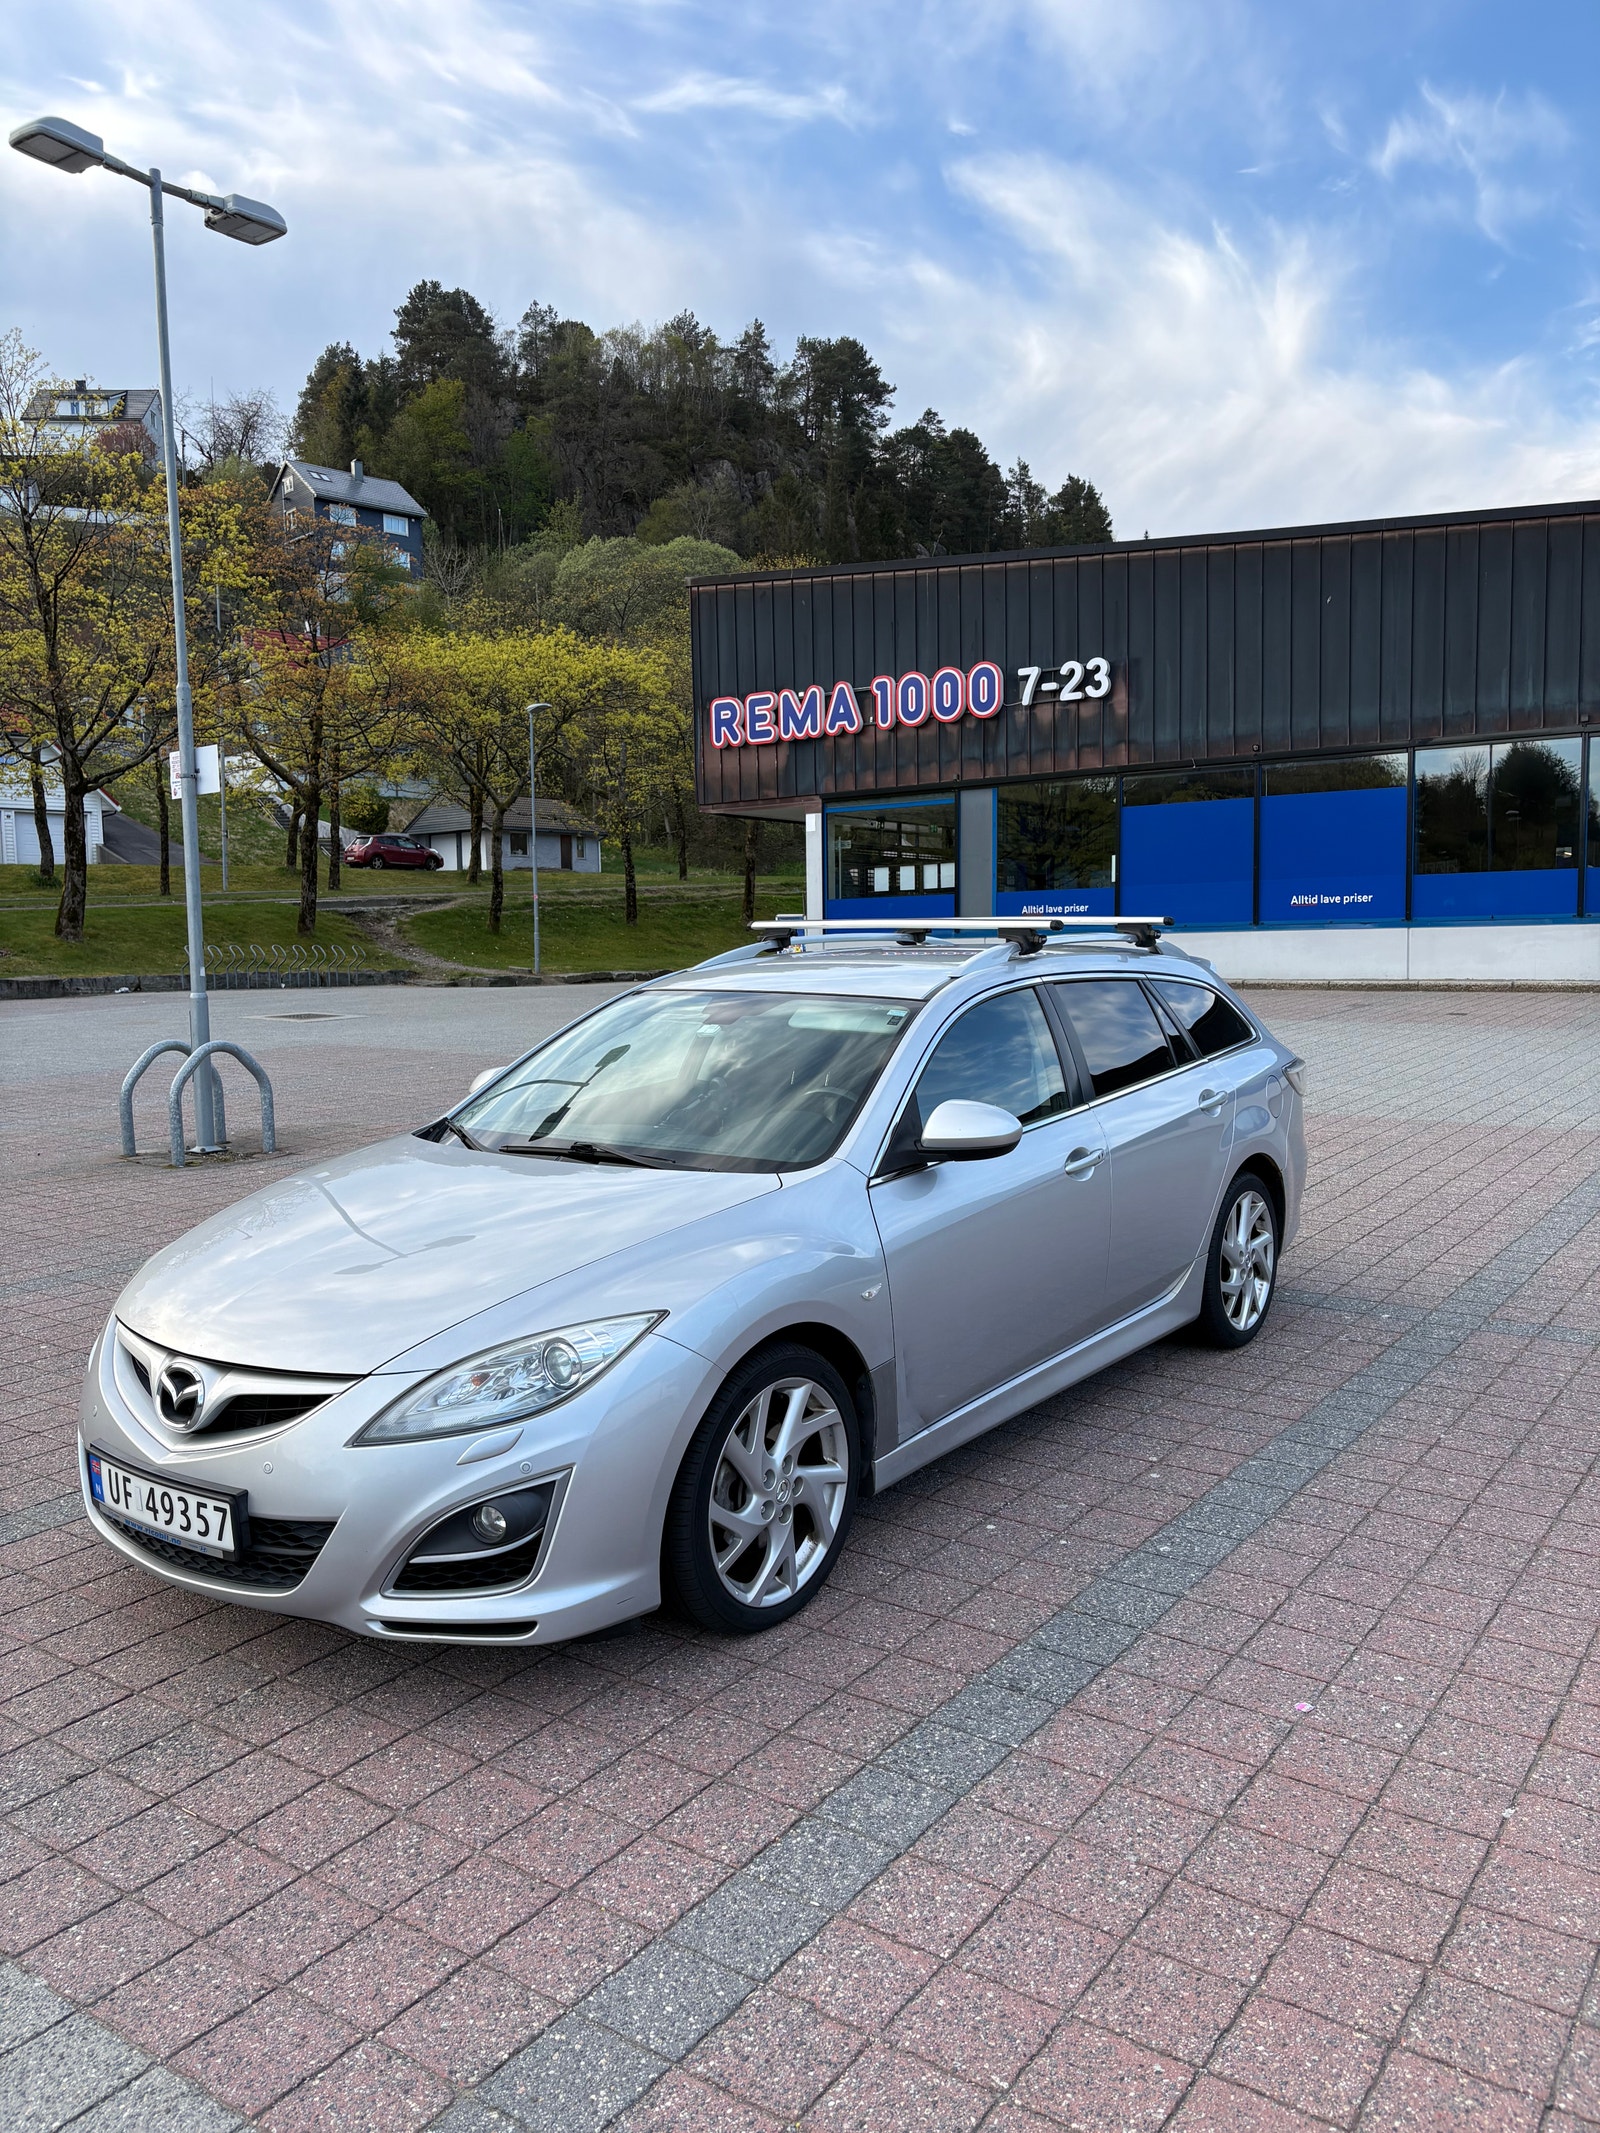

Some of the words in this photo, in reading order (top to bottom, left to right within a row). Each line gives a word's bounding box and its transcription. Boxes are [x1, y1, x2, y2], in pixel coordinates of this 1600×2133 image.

[710, 681, 862, 749] REMA
[870, 661, 1003, 730] 1000
[1017, 656, 1110, 706] 7-23
[1022, 905, 1044, 914] Alltid
[1045, 905, 1063, 913] lave
[1064, 904, 1089, 914] priser
[1290, 894, 1318, 905] Alltid
[1320, 894, 1341, 904] lave
[1343, 893, 1373, 905] priser
[108, 1468, 132, 1509] UF
[145, 1487, 228, 1542] 49357
